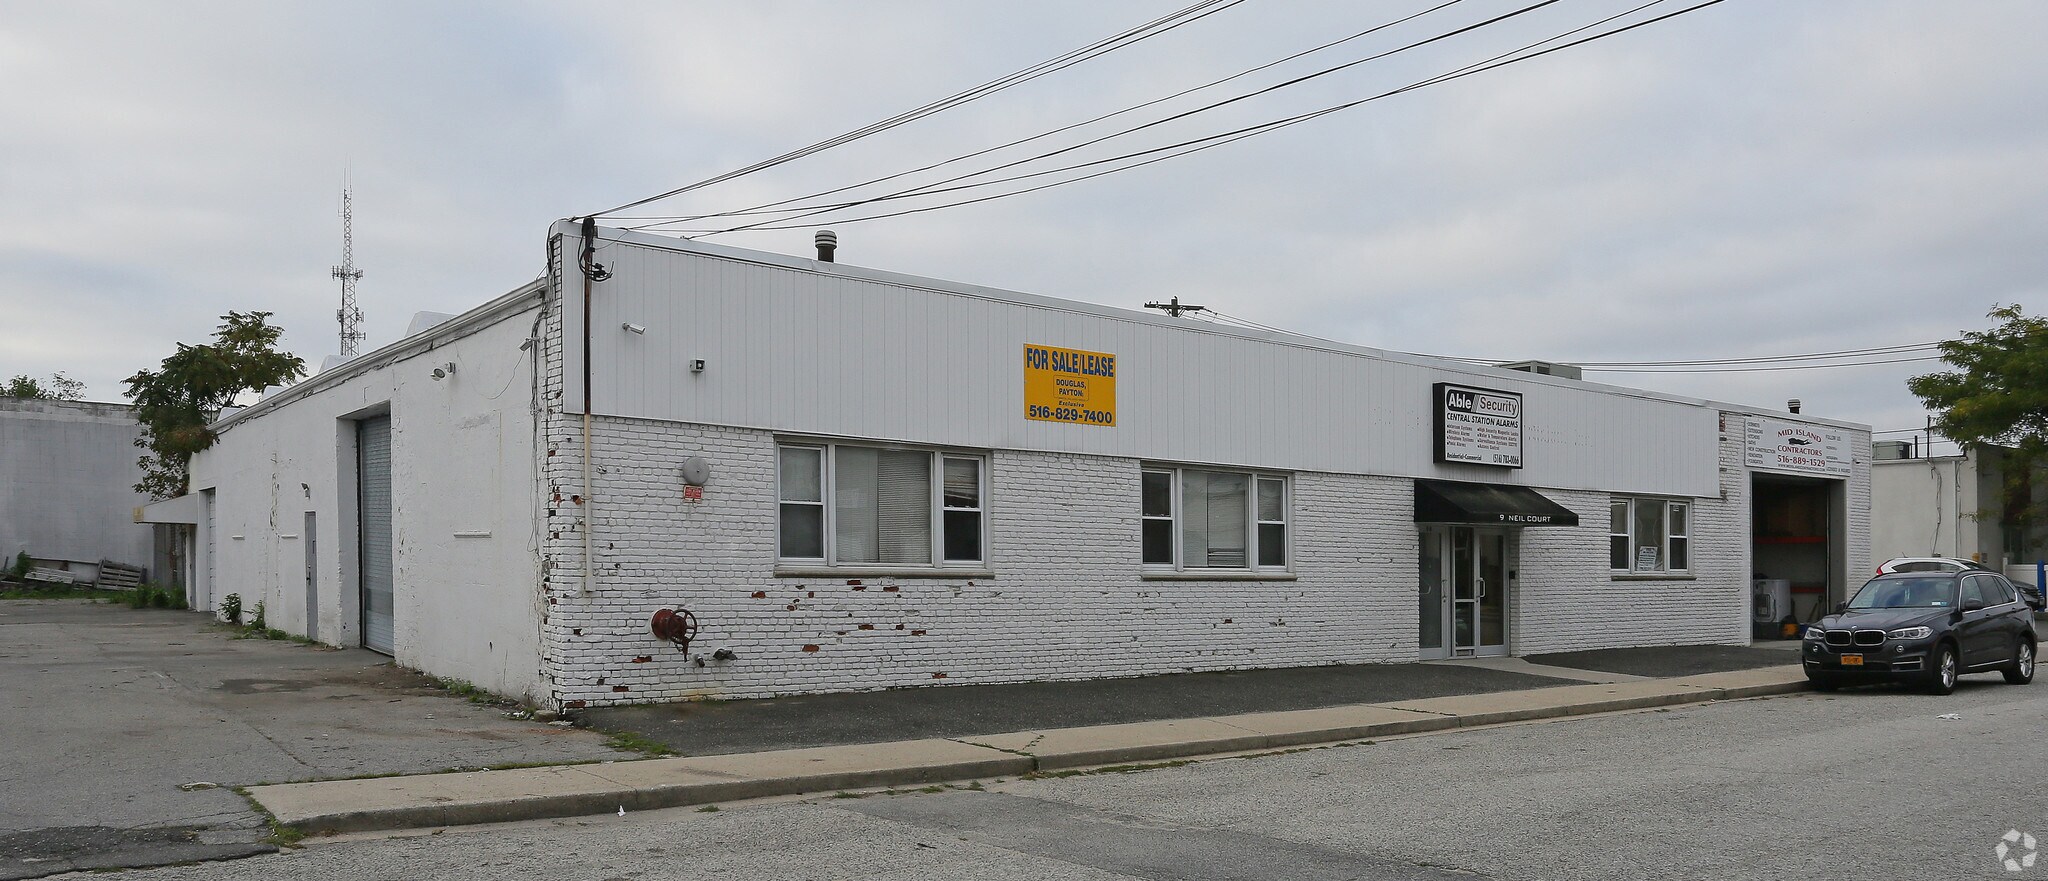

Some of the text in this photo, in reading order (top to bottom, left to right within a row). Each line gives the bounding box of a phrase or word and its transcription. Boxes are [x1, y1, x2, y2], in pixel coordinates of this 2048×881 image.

[1026, 347, 1114, 378] FOR SALE/LEASE
[1448, 393, 1517, 415] Able Security
[1029, 404, 1113, 424] 516-829-7400
[1446, 412, 1519, 429] CENTRAL STATION ALARMS
[1777, 428, 1822, 443] MID ISLAND
[1777, 444, 1823, 457] CONTRACTORS
[1777, 454, 1826, 467] 516-889-1529
[1508, 514, 1526, 522] NEIL
[1526, 515, 1551, 523] COURT
